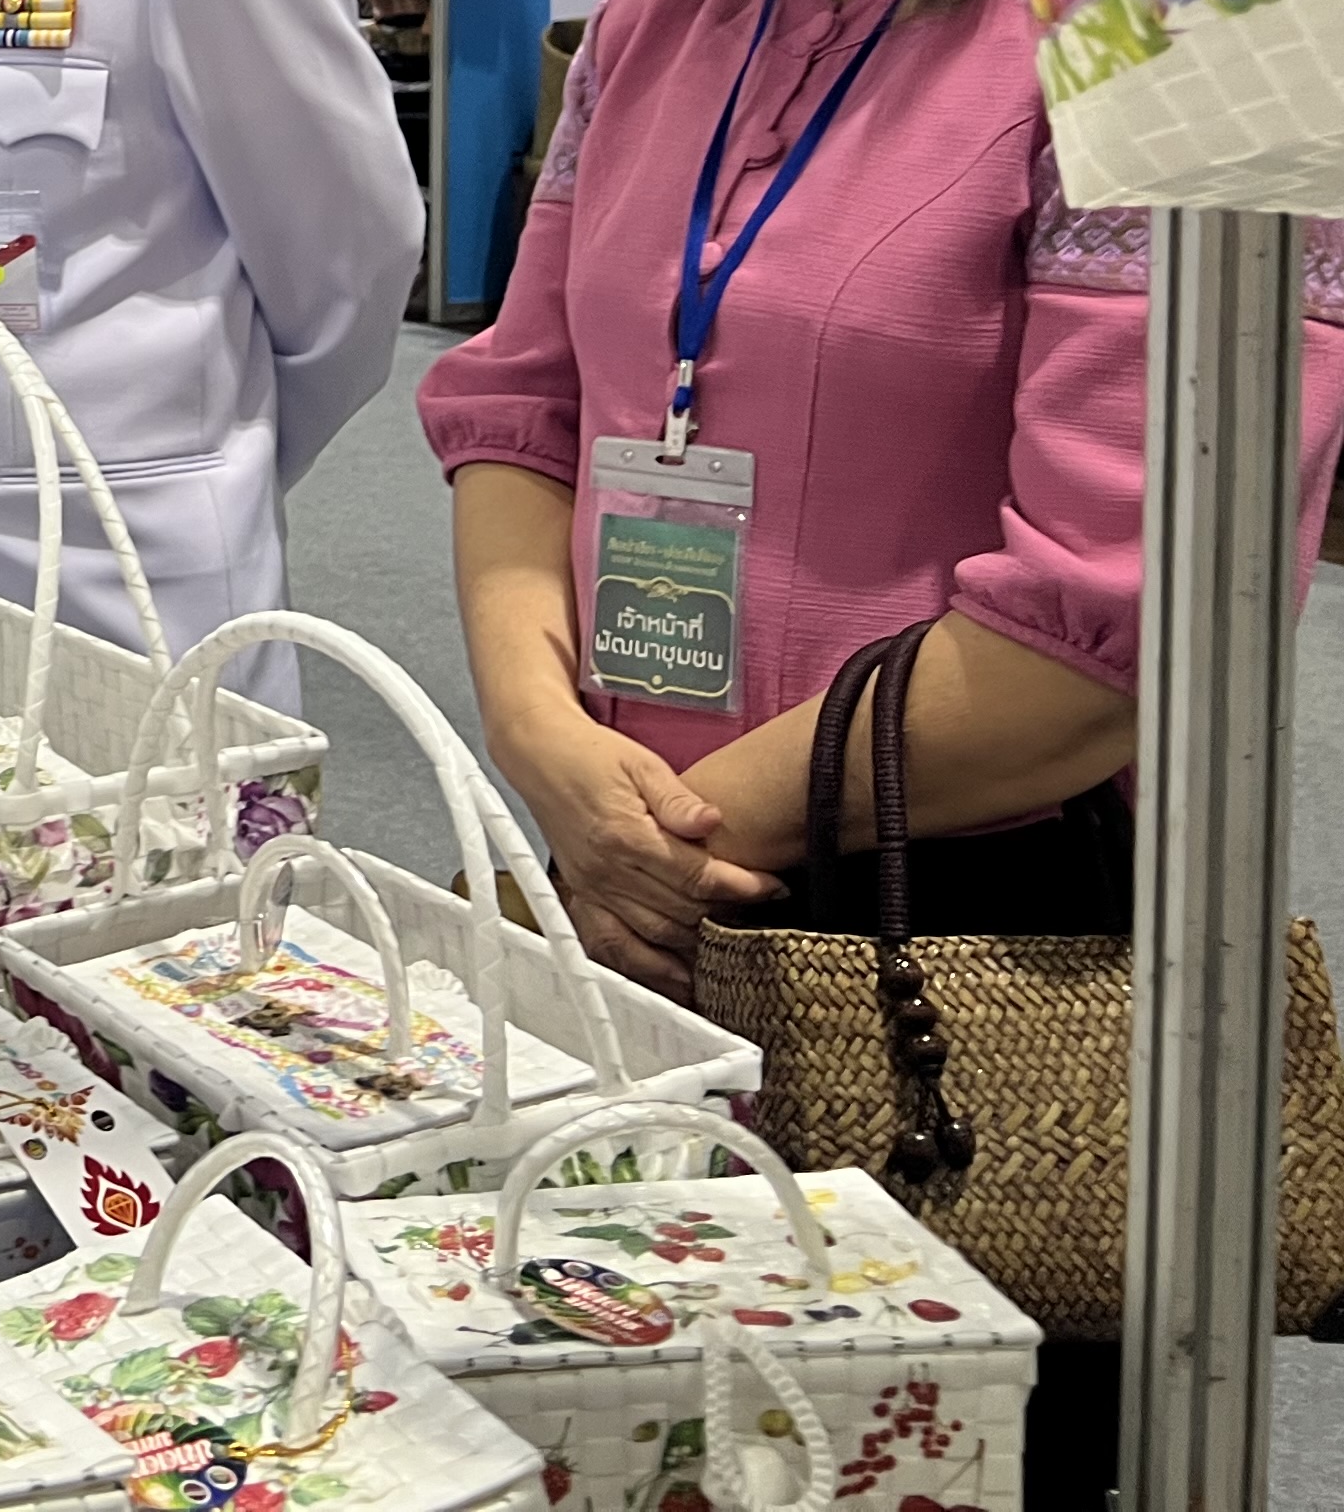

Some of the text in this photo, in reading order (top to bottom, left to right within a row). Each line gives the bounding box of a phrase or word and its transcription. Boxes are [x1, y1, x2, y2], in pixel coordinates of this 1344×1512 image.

[616, 606, 704, 642] เจ้าหน้าที่
[594, 629, 725, 672] พัฒนาชุมชน
